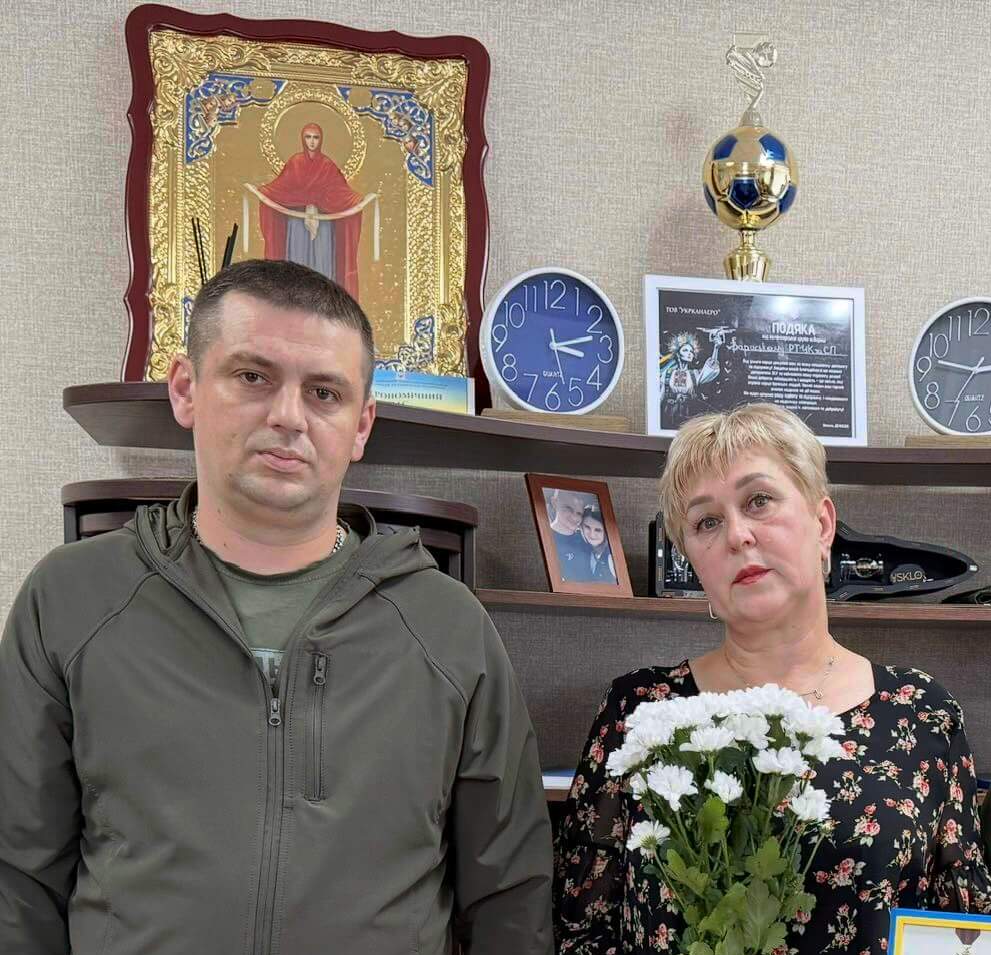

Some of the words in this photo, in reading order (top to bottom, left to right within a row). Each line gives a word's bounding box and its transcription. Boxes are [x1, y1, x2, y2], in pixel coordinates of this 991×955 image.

[523, 285, 537, 312] 11
[544, 280, 567, 310] 12
[575, 286, 580, 316] 1
[504, 301, 525, 328] 10
[586, 305, 603, 334] 2
[948, 315, 961, 341] 11
[968, 307, 990, 337] 12
[492, 324, 508, 353] 9
[771, 322, 816, 337] ПОДЯКА
[597, 334, 613, 364] 3
[929, 333, 949, 358] 10
[502, 353, 518, 382] 8
[586, 364, 602, 391] 4
[916, 356, 932, 382] 9
[523, 372, 539, 402] 7
[545, 382, 561, 411] 6
[568, 378, 584, 407] 5
[924, 381, 940, 410] 8
[944, 400, 960, 427] 7
[966, 405, 981, 432] 6
